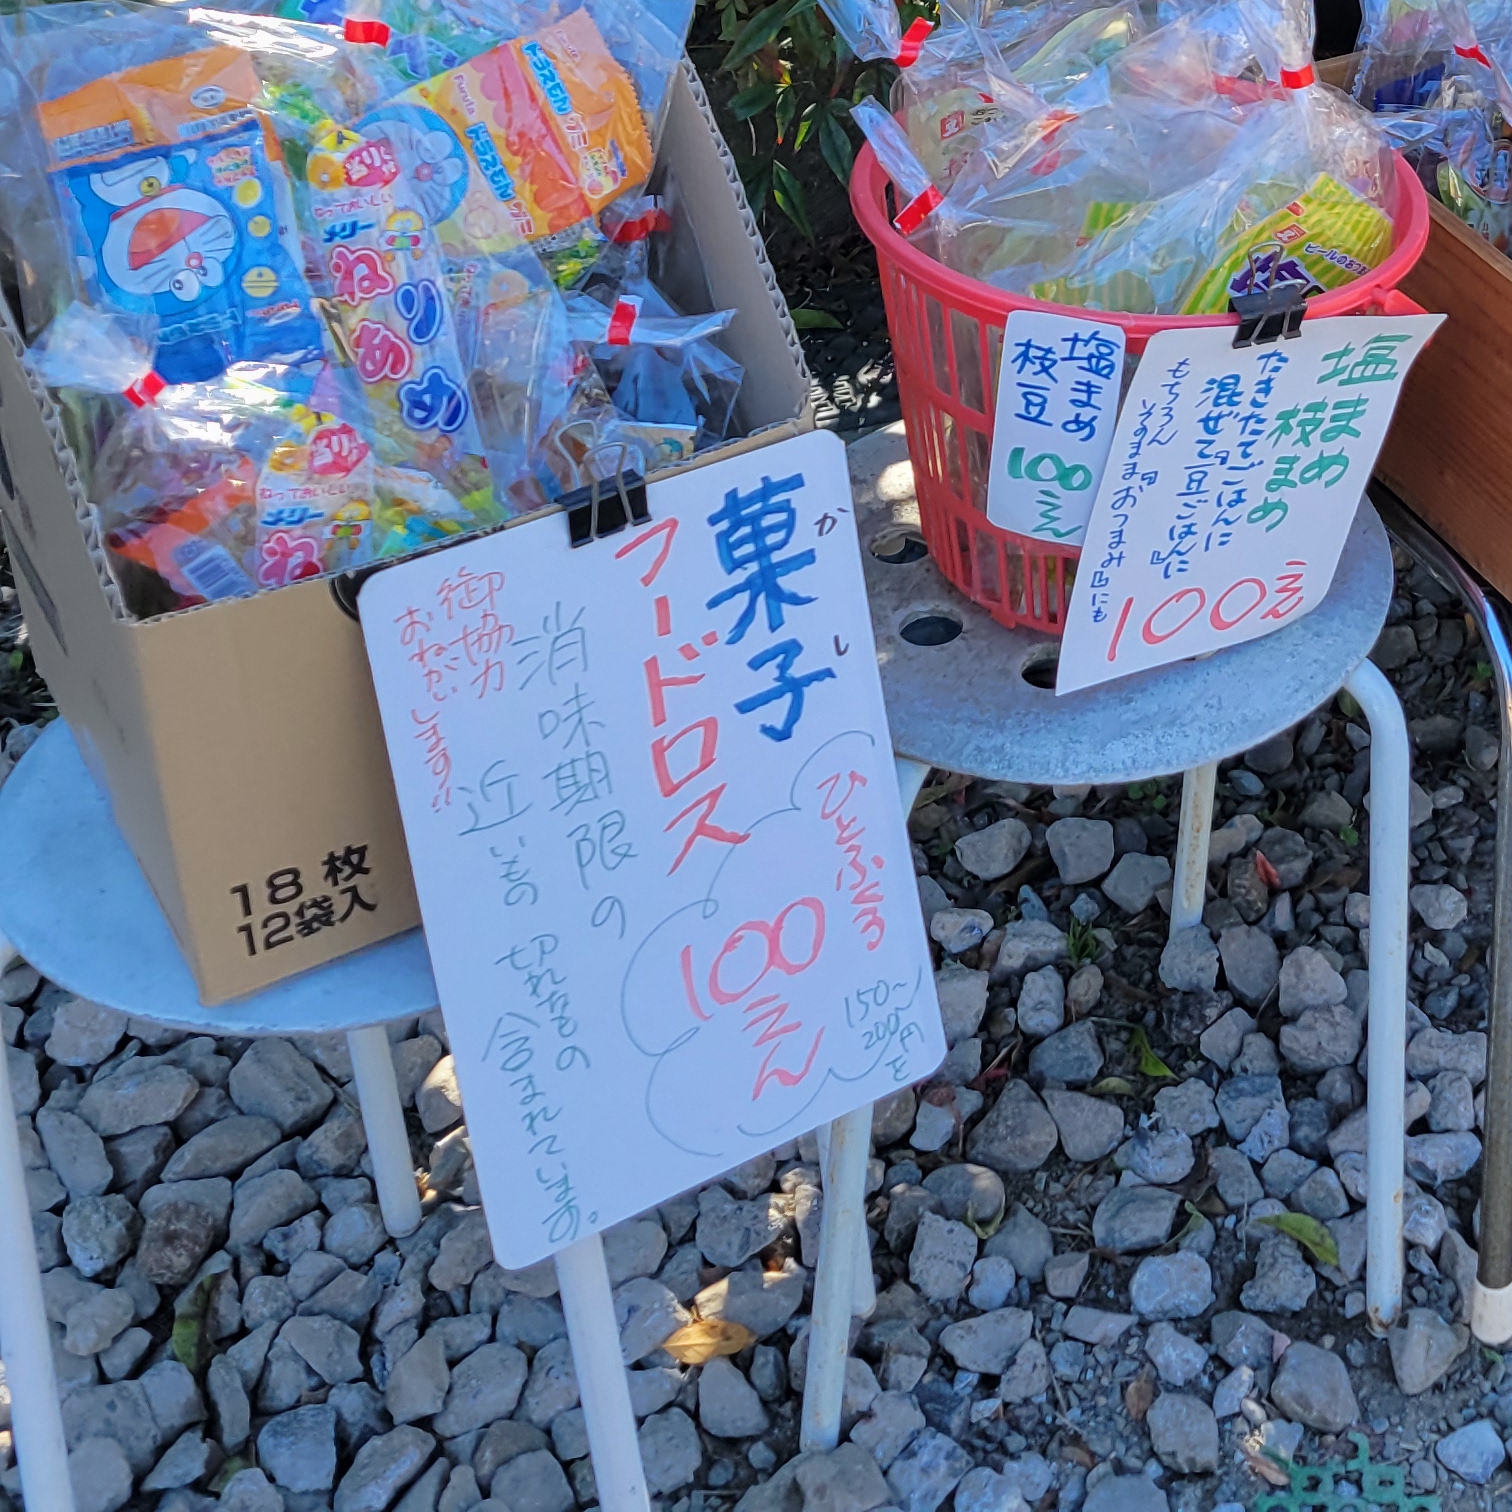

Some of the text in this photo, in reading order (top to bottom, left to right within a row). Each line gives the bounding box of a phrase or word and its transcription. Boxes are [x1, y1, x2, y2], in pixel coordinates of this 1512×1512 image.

[1010, 338, 1059, 427] 枝豆
[1060, 330, 1121, 443] 塩まめ
[1246, 395, 1327, 533] 枝まめ
[436, 565, 515, 700] 御協力
[706, 472, 836, 743] 菓子
[614, 515, 750, 876] フードロス
